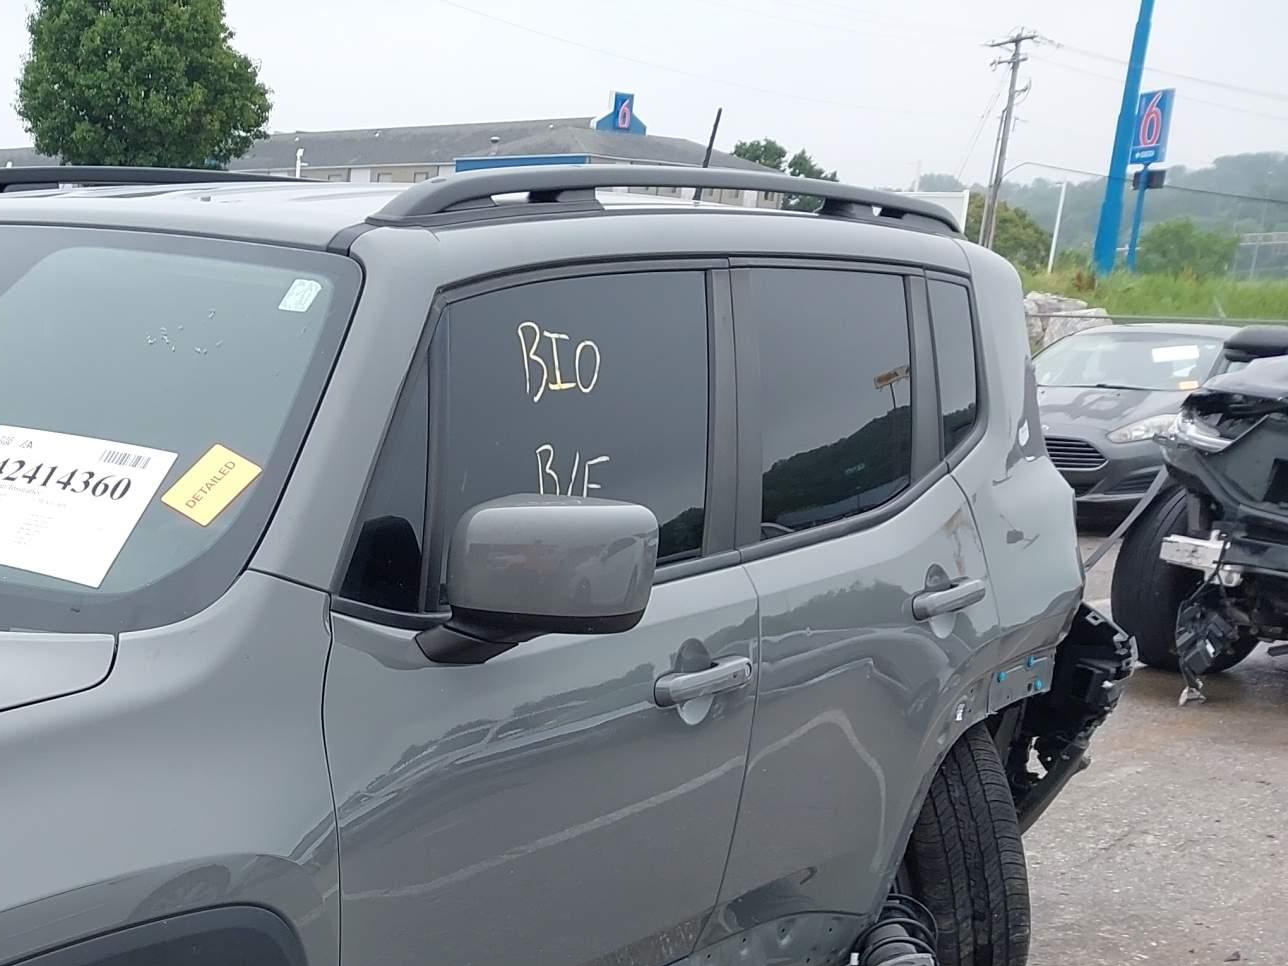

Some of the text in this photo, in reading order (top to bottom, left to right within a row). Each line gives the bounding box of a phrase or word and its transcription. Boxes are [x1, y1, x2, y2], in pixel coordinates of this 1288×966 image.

[618, 99, 631, 129] 6
[1139, 91, 1162, 146] 6
[518, 321, 601, 402] BIO
[185, 461, 236, 508] DETAILED
